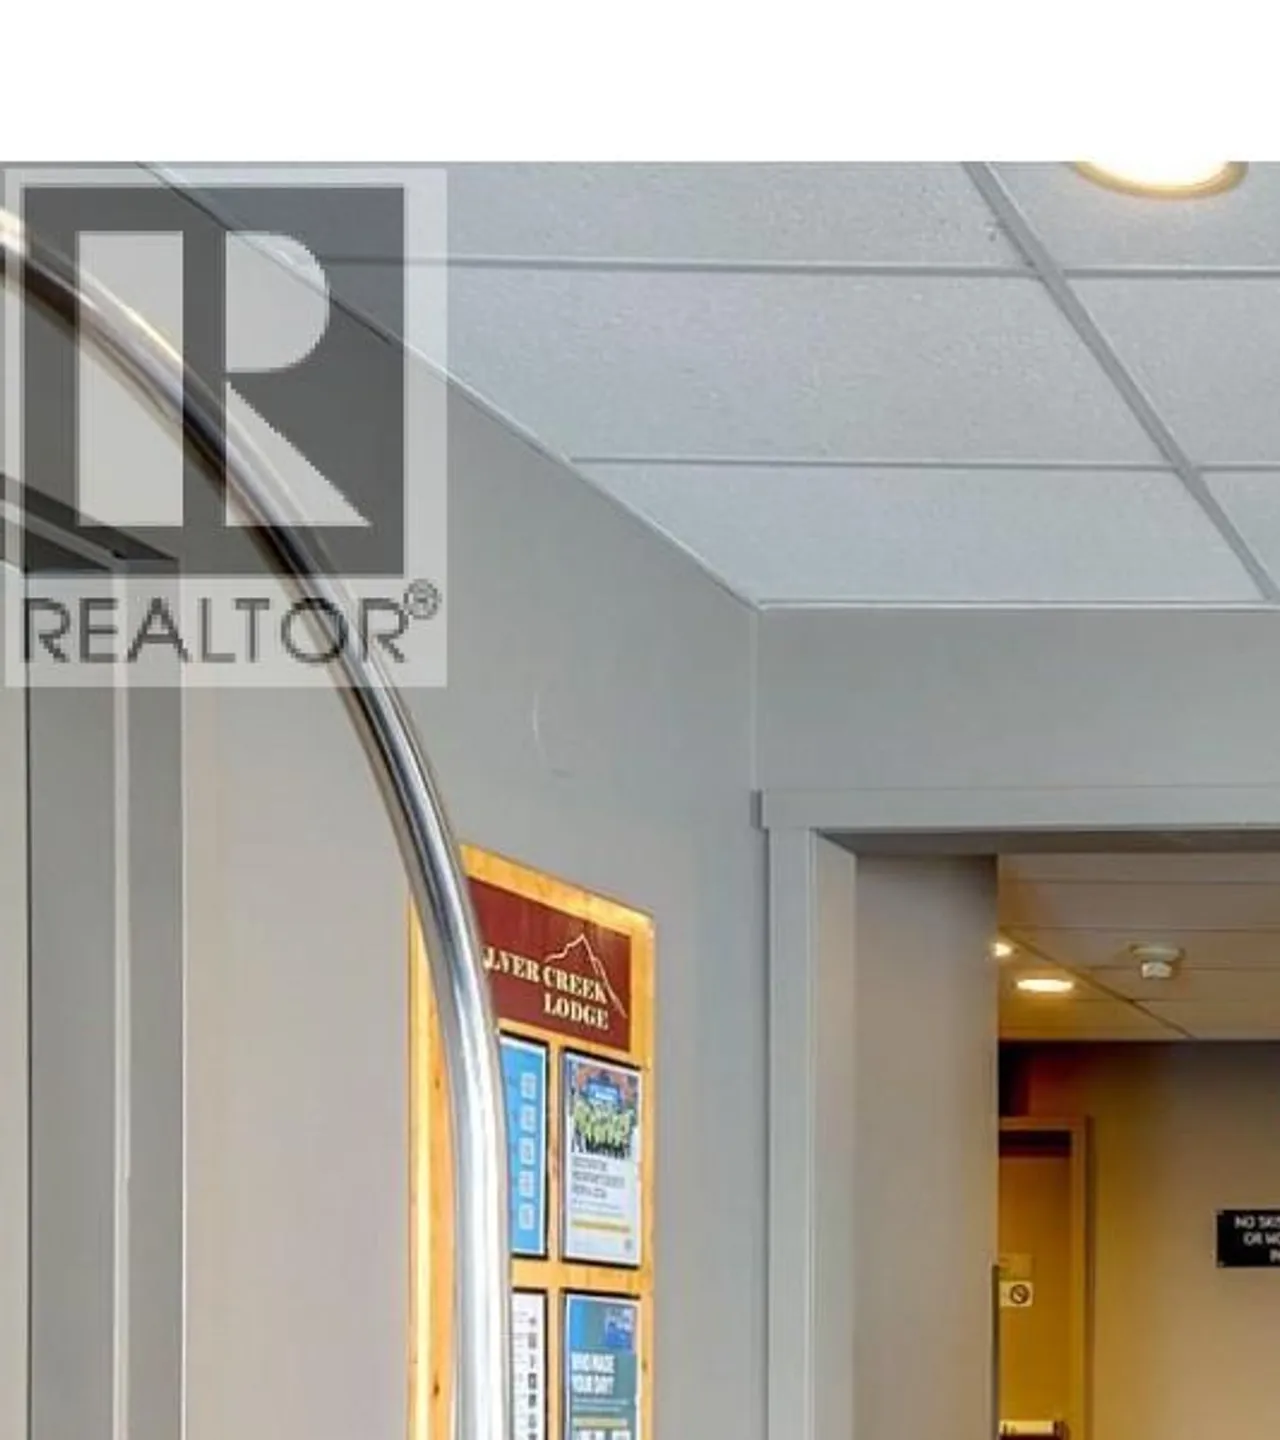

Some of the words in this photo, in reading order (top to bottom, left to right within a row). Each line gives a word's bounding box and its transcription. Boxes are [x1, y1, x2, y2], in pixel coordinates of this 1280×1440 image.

[543, 966, 608, 1005] CREEK
[543, 993, 610, 1030] LODGE
[1233, 1215, 1255, 1229] NO
[1243, 1231, 1263, 1245] OR
